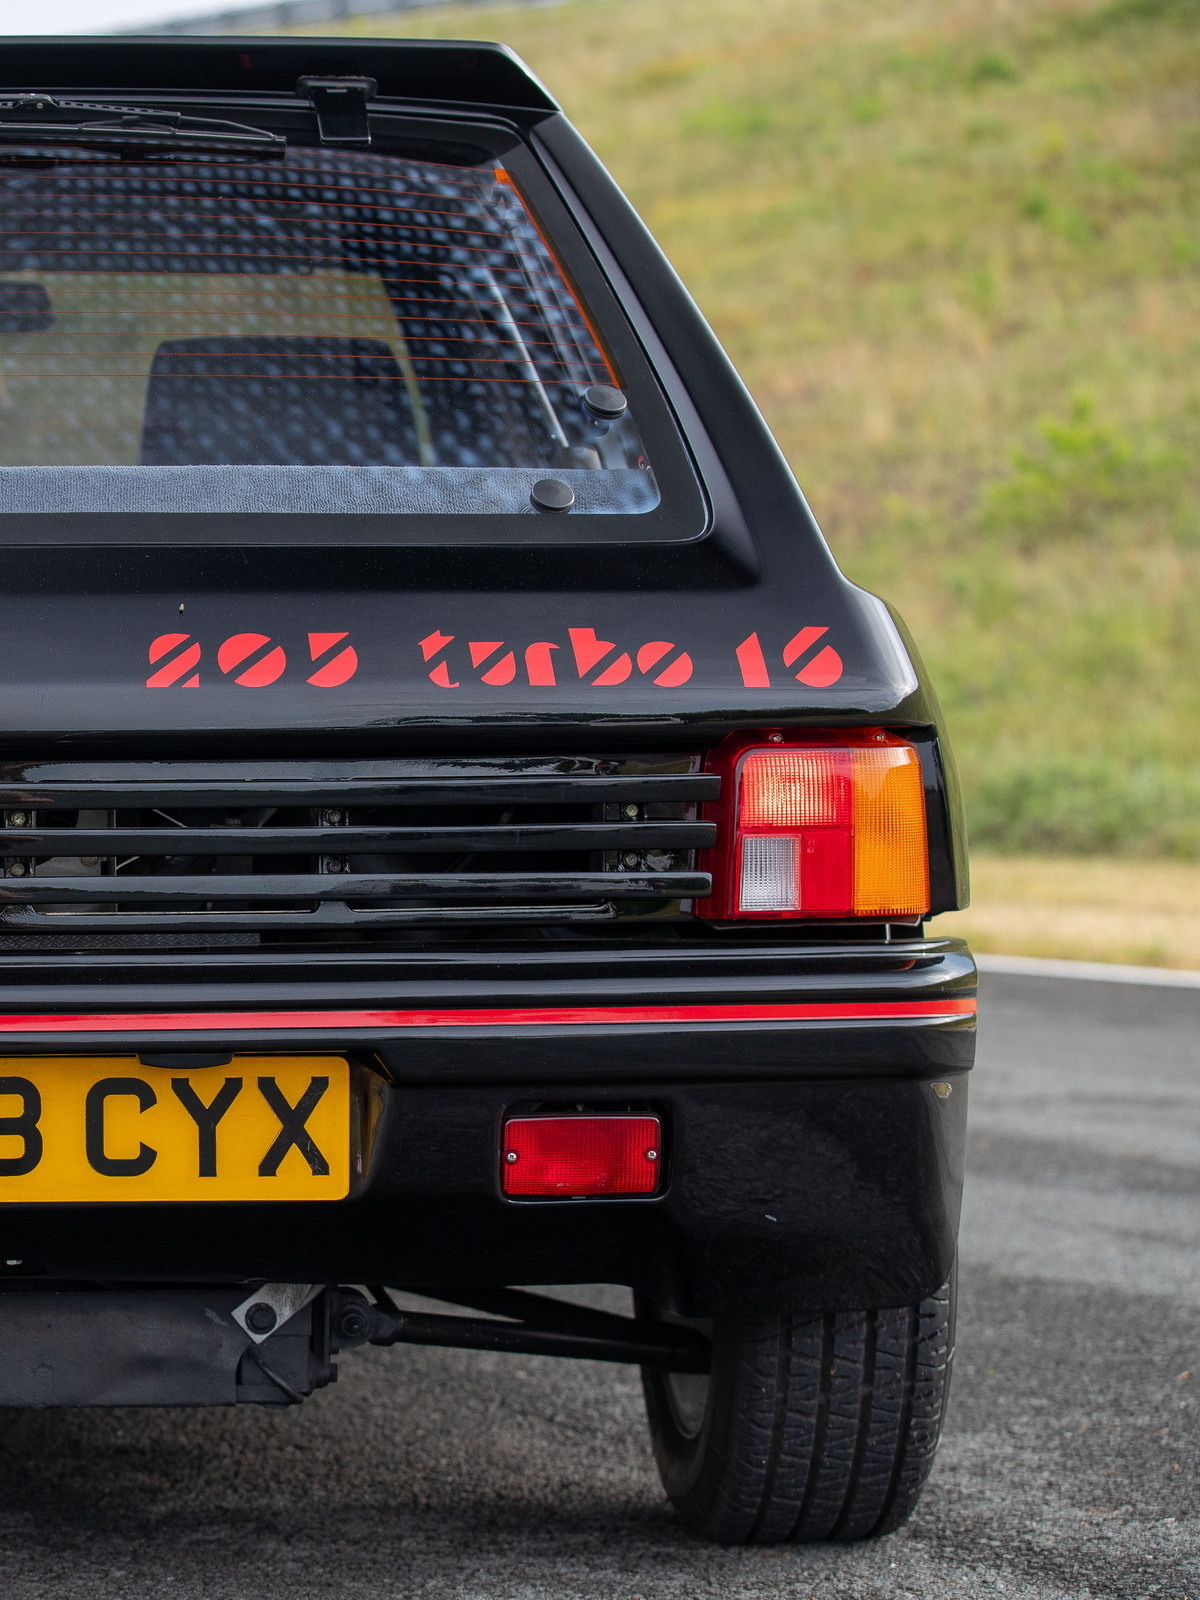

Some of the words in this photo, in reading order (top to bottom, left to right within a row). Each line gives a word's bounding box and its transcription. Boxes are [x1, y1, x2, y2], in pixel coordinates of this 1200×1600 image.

[146, 632, 358, 688] 205
[417, 627, 693, 688] turbo
[736, 626, 844, 688] 16
[85, 1076, 330, 1179] CYX
